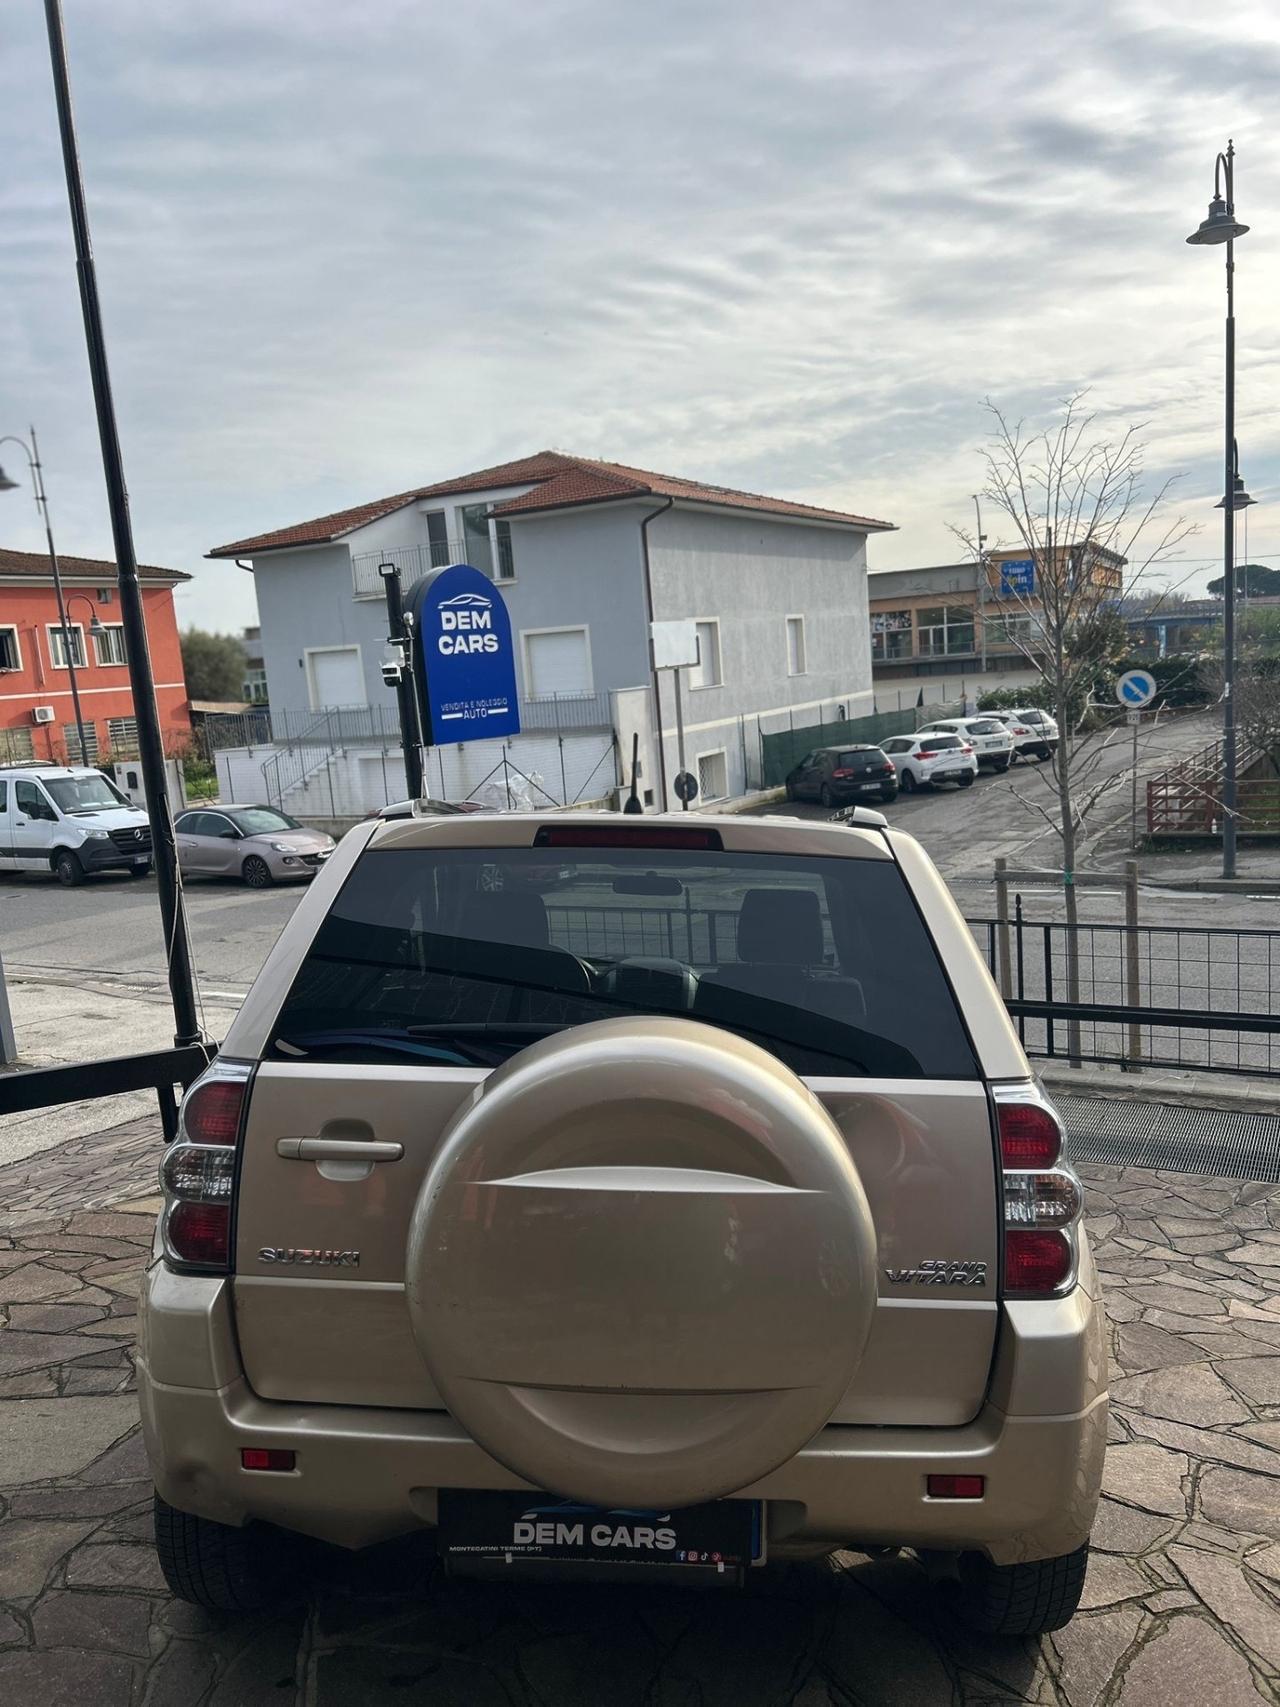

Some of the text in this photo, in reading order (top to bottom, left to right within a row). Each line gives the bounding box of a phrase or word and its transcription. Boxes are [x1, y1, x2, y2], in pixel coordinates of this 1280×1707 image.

[441, 611, 491, 630] DEM
[438, 634, 498, 655] CARS
[441, 702, 469, 711] VENDITA
[464, 708, 487, 719] AUTO
[258, 1247, 360, 1267] SUZUKI
[919, 1260, 987, 1271] GRAND
[885, 1269, 986, 1286] VITARA
[514, 1523, 676, 1550] DEM CARS
